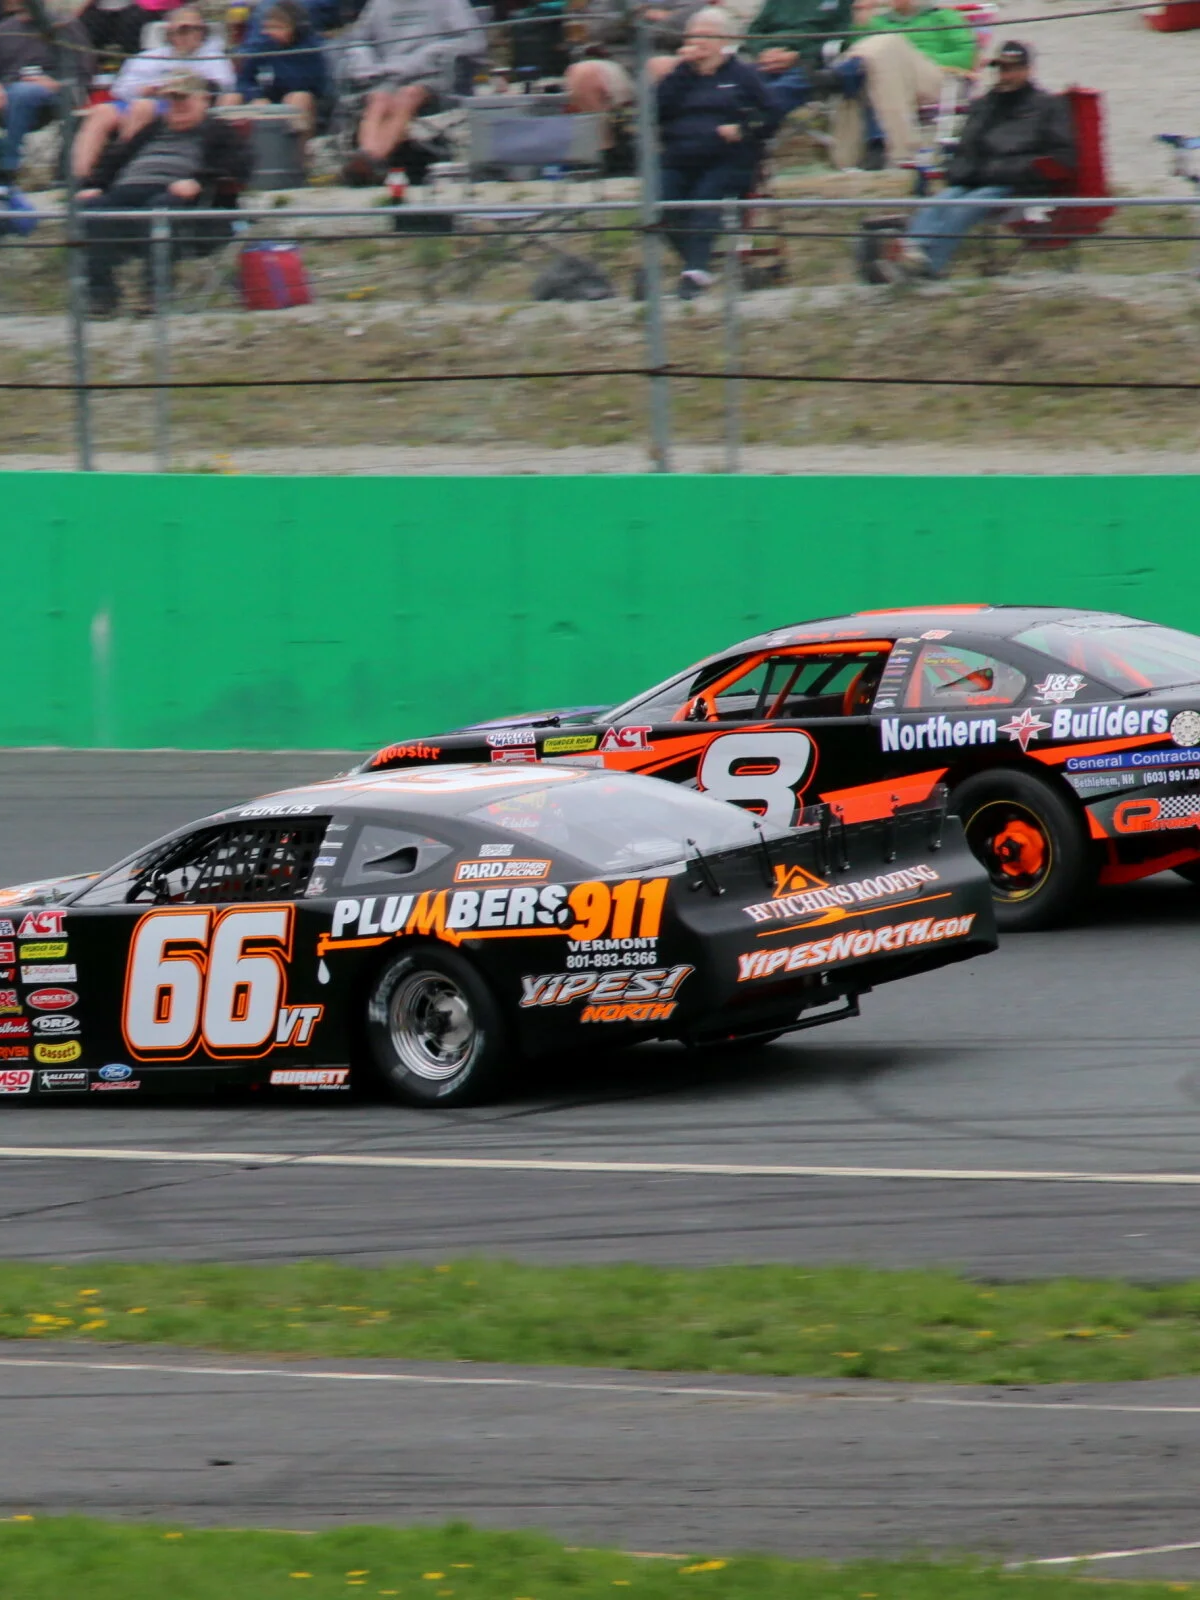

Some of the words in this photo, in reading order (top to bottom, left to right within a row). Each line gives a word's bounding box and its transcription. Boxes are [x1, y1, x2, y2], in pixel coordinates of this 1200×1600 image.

[1040, 673, 1084, 691] J&S
[600, 726, 652, 748] ACT
[881, 715, 996, 751] Northern
[1052, 706, 1169, 738] Builders
[495, 737, 533, 746] MASTER
[546, 738, 574, 747] THUNDER
[576, 737, 594, 745] ROAD
[372, 742, 440, 766] Hoosier
[1067, 755, 1122, 770] General
[696, 728, 819, 827] 8
[1121, 774, 1135, 785] NH
[1143, 771, 1167, 785] (603)
[458, 863, 503, 879] PARD
[502, 869, 543, 877] RACING
[505, 862, 548, 870] BROTHERS
[743, 884, 853, 923] HUTCHINS
[848, 864, 939, 902] ROOFING
[332, 884, 569, 938] PLUMBERS
[568, 877, 670, 942] 911
[18, 911, 67, 934] ACT
[567, 937, 658, 952] VERMONT
[566, 951, 657, 969] 801-893-6366
[121, 903, 295, 1062] 66
[519, 964, 695, 1007] YIPES!
[580, 1001, 679, 1023] NORTH
[39, 1018, 73, 1028] DRP
[273, 1004, 324, 1046] VT
[40, 1046, 76, 1058] Bassett
[270, 1069, 349, 1085] BURNETT
